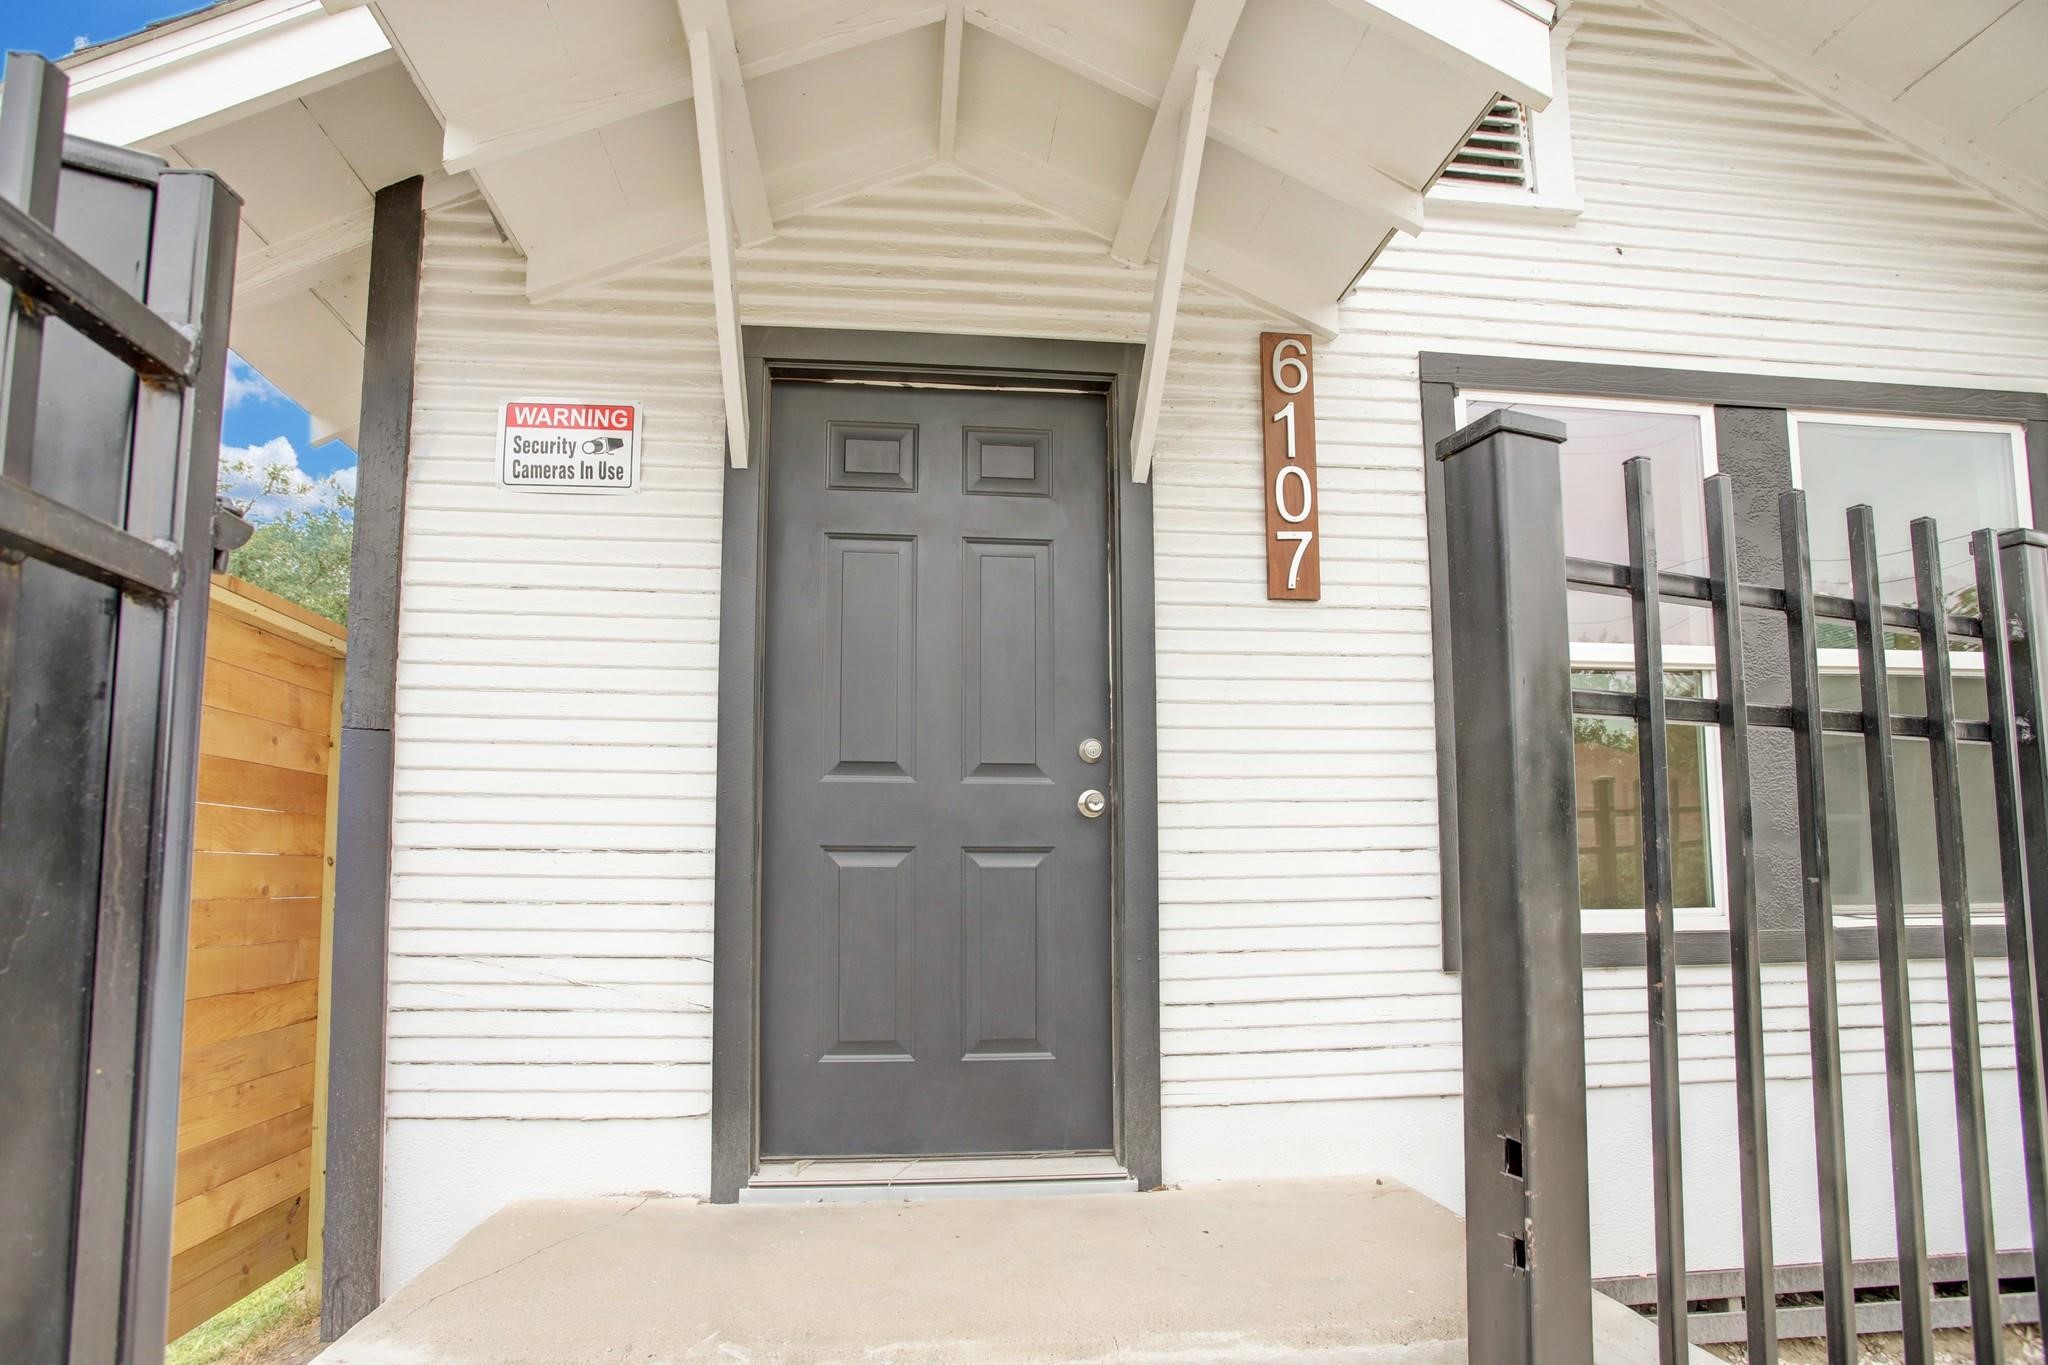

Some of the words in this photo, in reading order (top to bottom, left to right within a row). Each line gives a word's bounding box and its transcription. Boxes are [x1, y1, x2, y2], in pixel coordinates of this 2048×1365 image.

[514, 406, 628, 428] WARNING
[513, 435, 577, 459] Security
[512, 459, 575, 480] Cameras
[580, 460, 594, 480] In
[598, 461, 624, 481] Use
[1271, 338, 1313, 590] 6107
